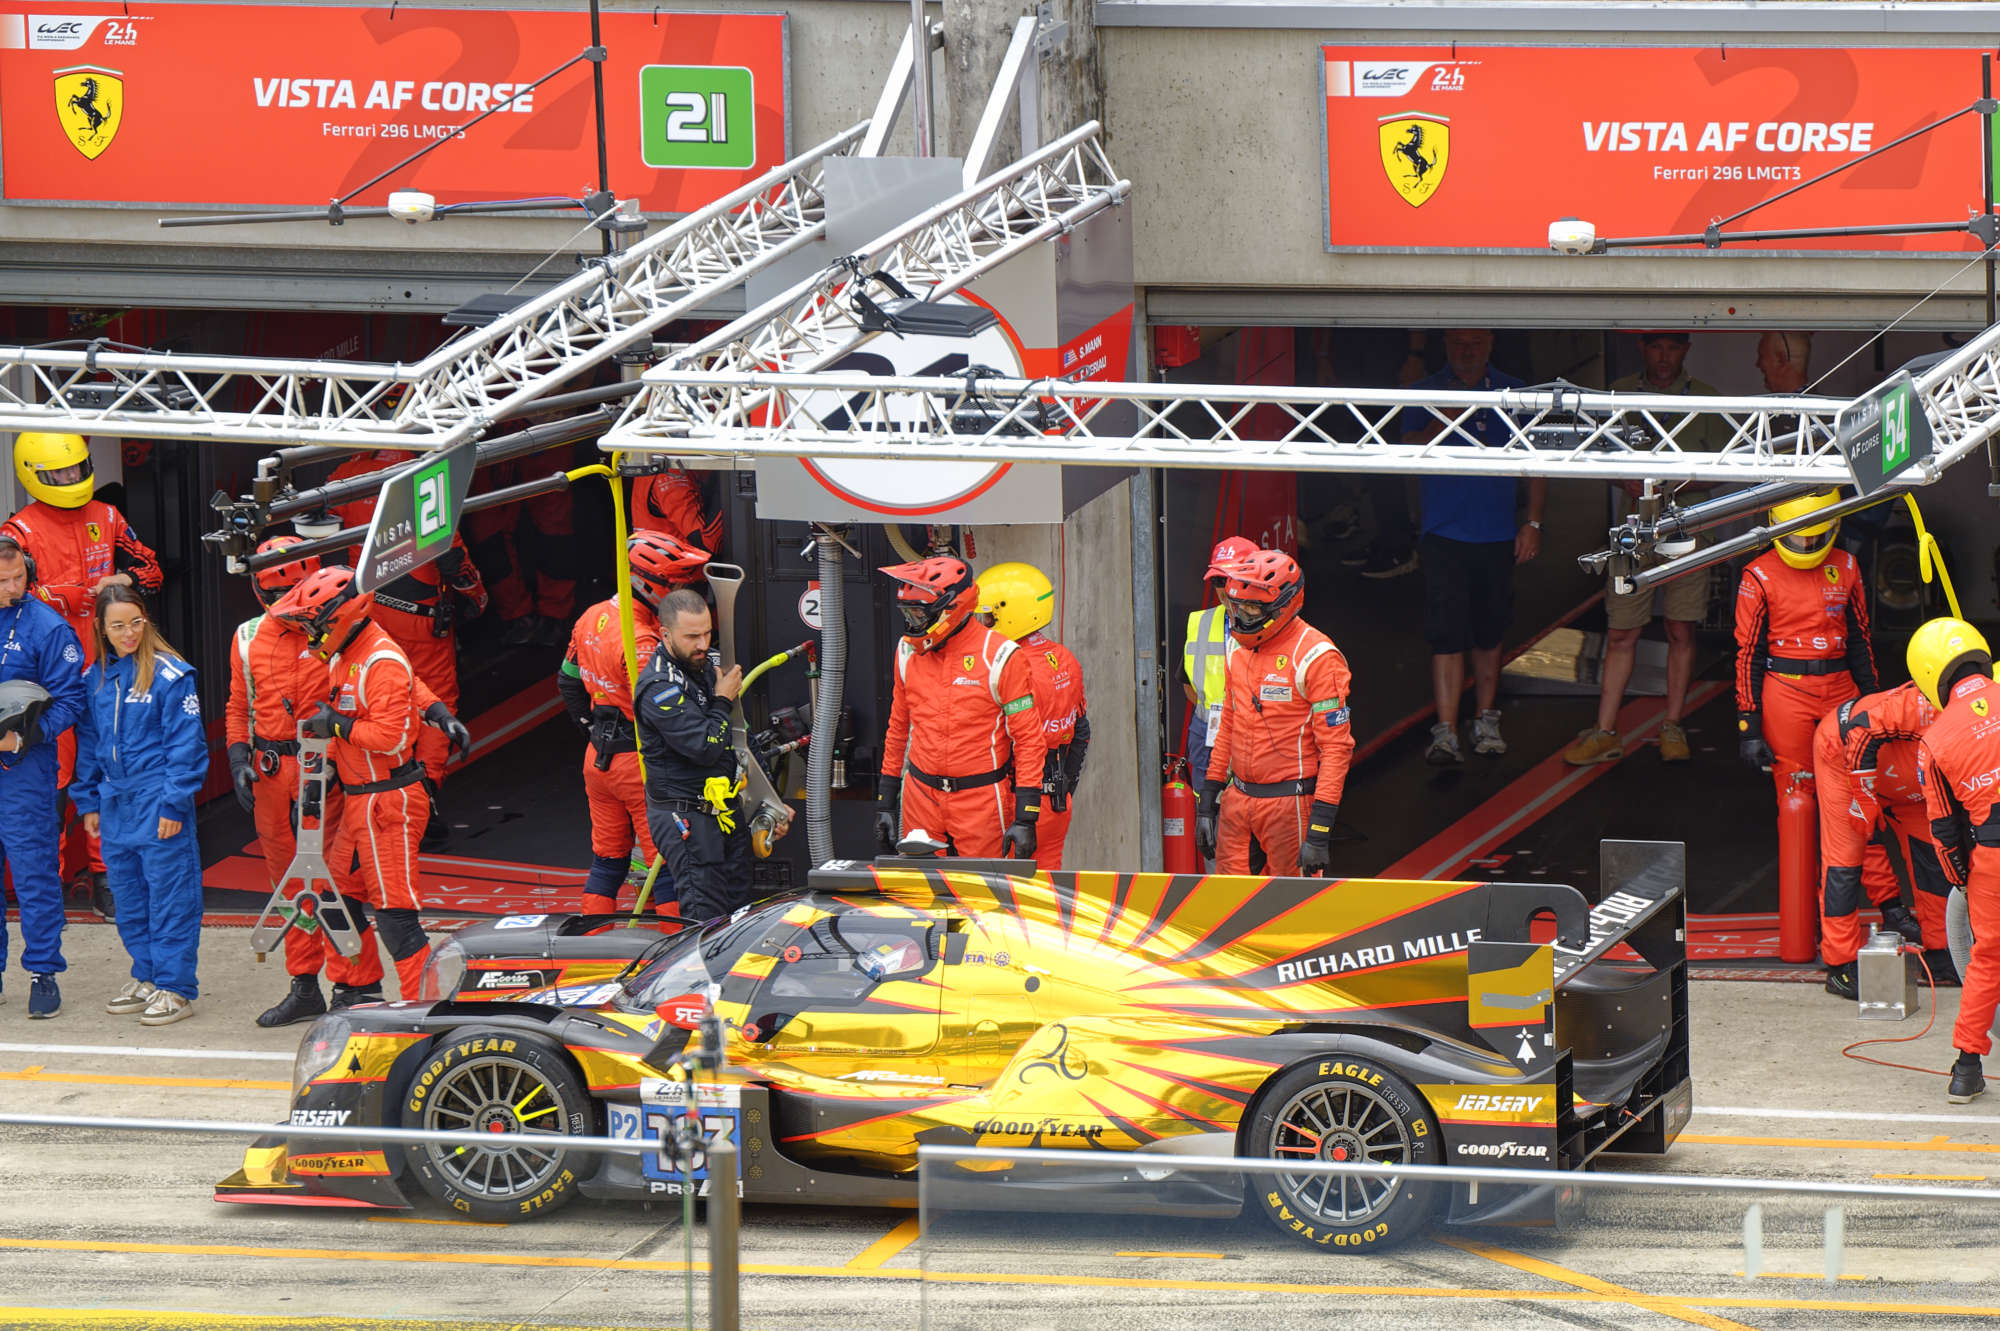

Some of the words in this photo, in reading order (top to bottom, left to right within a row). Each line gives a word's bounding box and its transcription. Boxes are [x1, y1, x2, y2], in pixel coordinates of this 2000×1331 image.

[37, 22, 82, 34] WEC
[105, 22, 137, 40] 24h
[1362, 68, 1409, 80] WEC
[1432, 67, 1465, 86] 24h
[253, 77, 356, 109] VISTA
[364, 80, 415, 110] AF
[421, 81, 536, 113] CORSE
[665, 91, 728, 143] 21
[322, 122, 376, 137] Ferrari
[380, 124, 409, 138] 296
[413, 125, 466, 139] LMGT3
[1582, 122, 1689, 152] VISTA
[1696, 122, 1750, 152] AF
[1755, 122, 1875, 152] CORSE
[1653, 165, 1709, 180] Ferrari
[1712, 165, 1743, 180] 296
[1747, 166, 1801, 181] LMGT3
[1850, 401, 1880, 428] VISTA
[1885, 392, 1907, 463] 54
[1851, 443, 1861, 461] AF
[1861, 433, 1880, 454] CORSE
[419, 471, 446, 538] 21
[374, 519, 413, 548] VISTA
[375, 560, 390, 579] AF
[389, 552, 413, 571] CORSE
[805, 599, 820, 616] 2
[1961, 767, 2000, 791] VIST
[965, 953, 985, 964] FIA
[1277, 943, 1396, 984] RICHARD
[1403, 928, 1482, 960] MILLE
[477, 971, 503, 988] AF
[409, 1038, 517, 1113] GOODYEAR
[1318, 1062, 1384, 1088] EAGLE
[611, 1110, 639, 1140] P2
[973, 1114, 1104, 1138] GOODYEAR
[1411, 1118, 1428, 1137] M
[1457, 1141, 1548, 1158] GOODYEAR
[294, 1156, 365, 1171] GOODYEAR
[519, 1168, 575, 1214] EAGLE
[1267, 1191, 1389, 1247] GOODYEAR
